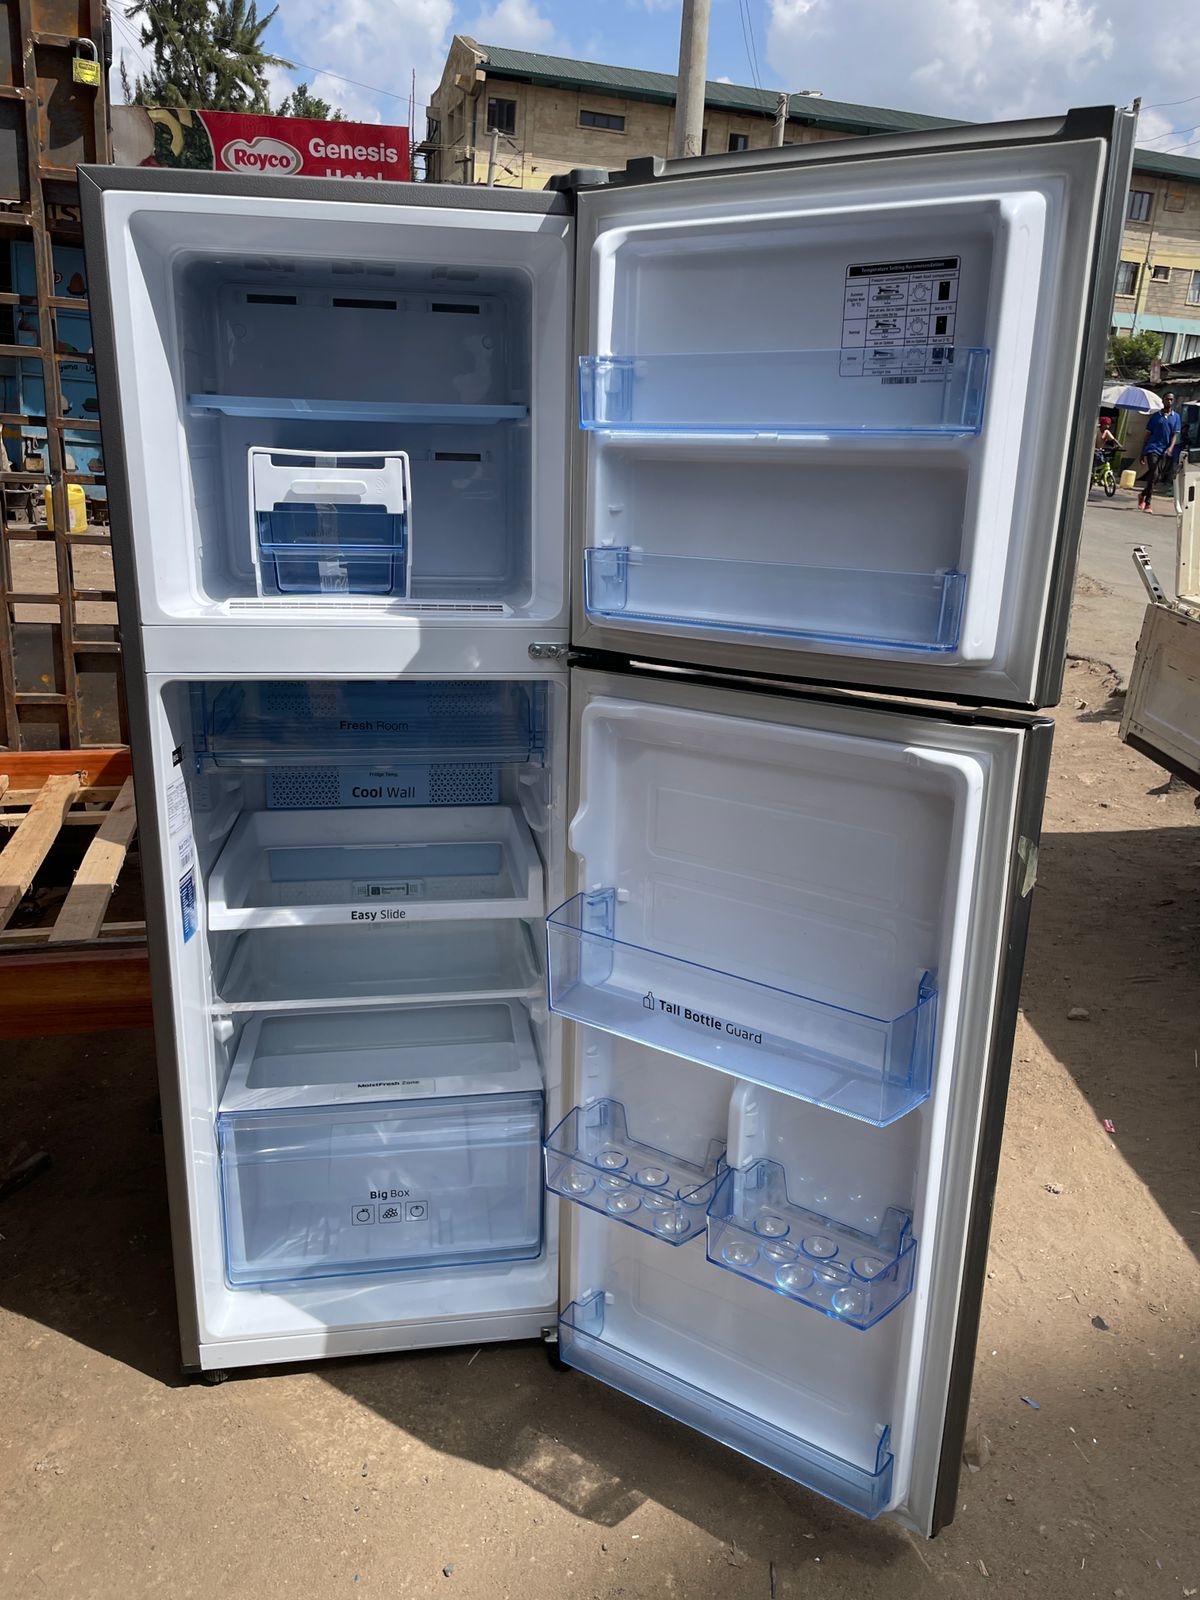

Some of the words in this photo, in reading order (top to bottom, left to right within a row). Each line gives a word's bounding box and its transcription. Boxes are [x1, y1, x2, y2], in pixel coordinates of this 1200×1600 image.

[308, 137, 398, 163] Genesis
[234, 148, 291, 171] Royco
[339, 720, 373, 730] Fresh
[376, 720, 409, 731] Room
[352, 786, 383, 798] Cool
[386, 786, 416, 798] Wall
[351, 910, 377, 921] Easy
[380, 908, 406, 920] Slide
[659, 999, 680, 1016] Tall
[684, 1008, 722, 1031] Bottle
[725, 1023, 762, 1045] Guard
[370, 1190, 388, 1201] Big
[390, 1189, 410, 1198] Box
